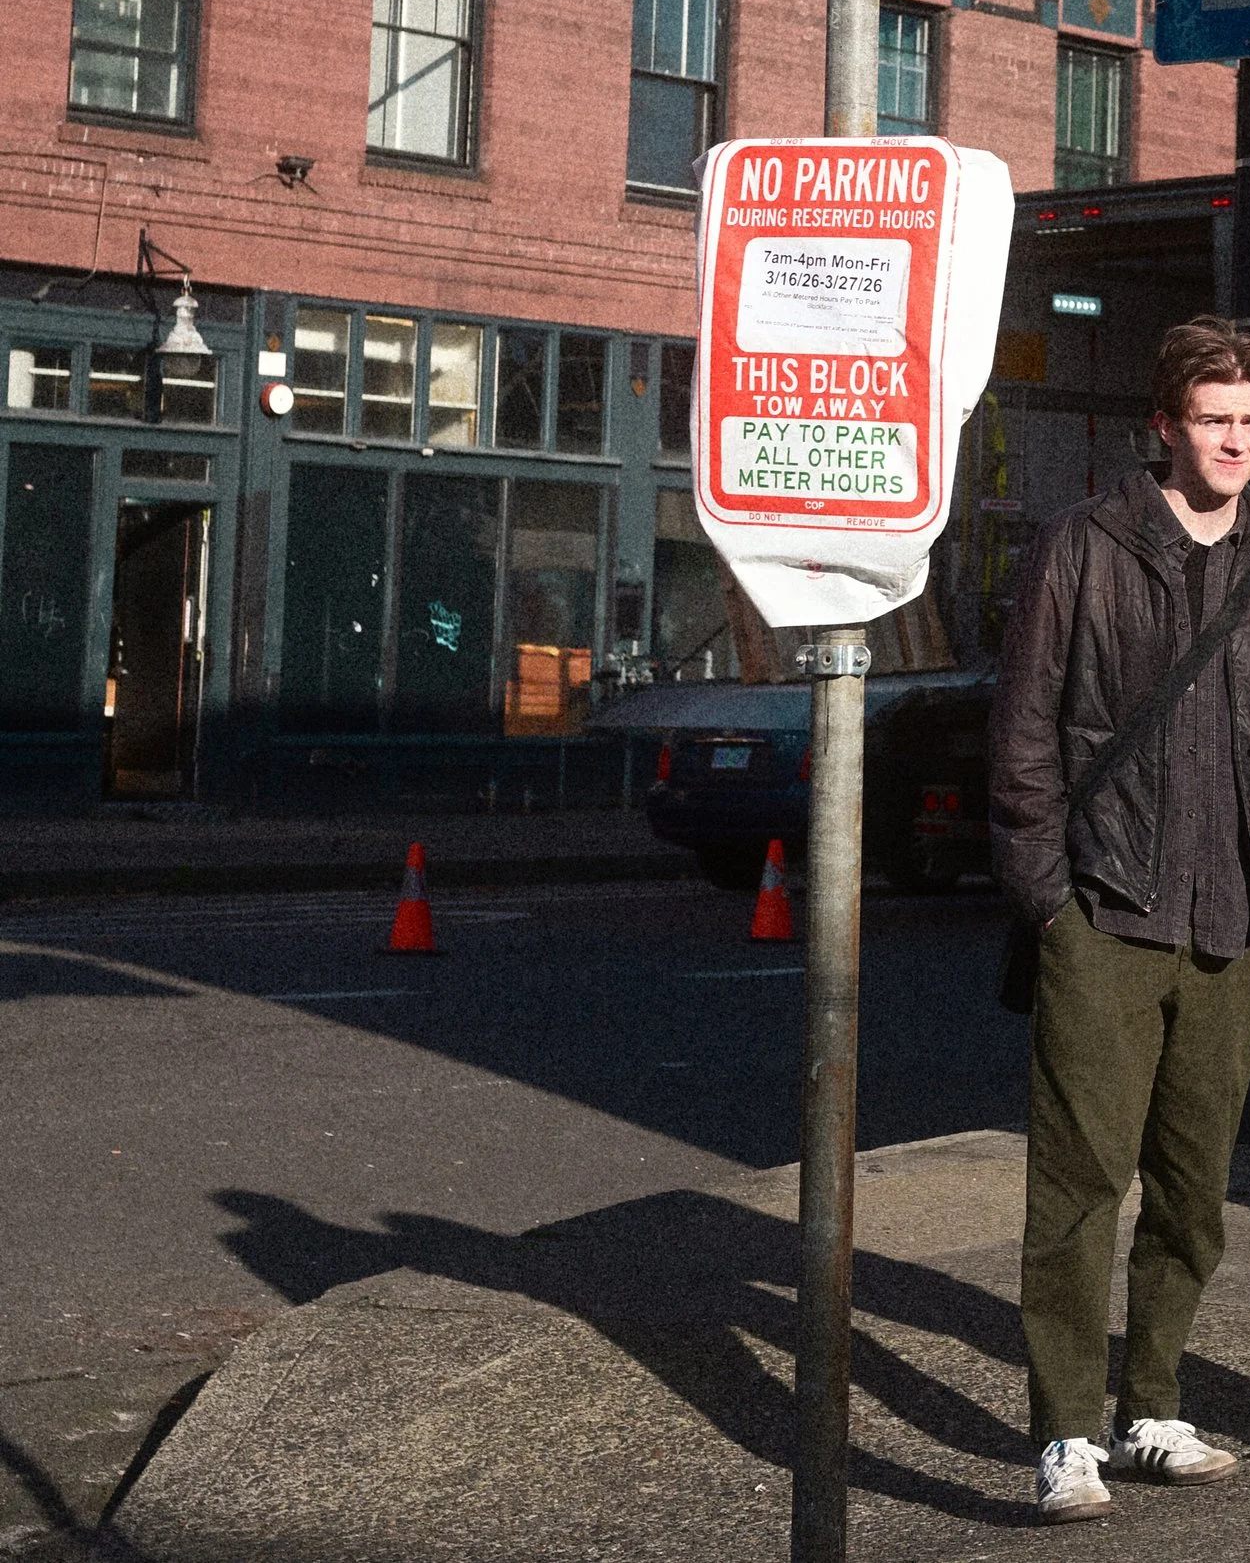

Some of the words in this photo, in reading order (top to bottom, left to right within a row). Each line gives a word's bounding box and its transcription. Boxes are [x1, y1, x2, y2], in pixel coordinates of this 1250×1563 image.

[870, 138, 909, 146] REMOVE
[740, 157, 783, 202] NO
[795, 157, 930, 204] PARKING
[726, 207, 788, 227] DURING
[791, 208, 874, 229] RESERVED
[879, 209, 936, 230] HOURS
[763, 250, 827, 270] 7am-4pm
[831, 254, 890, 272] Mon-Fri
[765, 270, 882, 294] 3/16/26-3/27/26
[773, 291, 792, 299] Other
[793, 292, 818, 301] Metered
[819, 295, 838, 303] Hours
[840, 296, 853, 305] Pay
[855, 296, 864, 304] To
[865, 297, 880, 305] Park
[731, 357, 799, 391] THIS
[810, 359, 909, 397] BLOCK
[752, 395, 803, 417] TOW
[811, 397, 886, 419] AWAY
[742, 422, 791, 441] PAY
[801, 424, 825, 443] TO
[835, 426, 902, 446] PARK
[755, 446, 799, 467] ALL
[808, 448, 885, 470] OTHER
[738, 469, 810, 491] METER
[821, 474, 904, 495] HOURS
[804, 501, 825, 510] COP
[749, 513, 762, 521] DO
[763, 513, 782, 522] NOT
[846, 517, 886, 527] REMOVE
